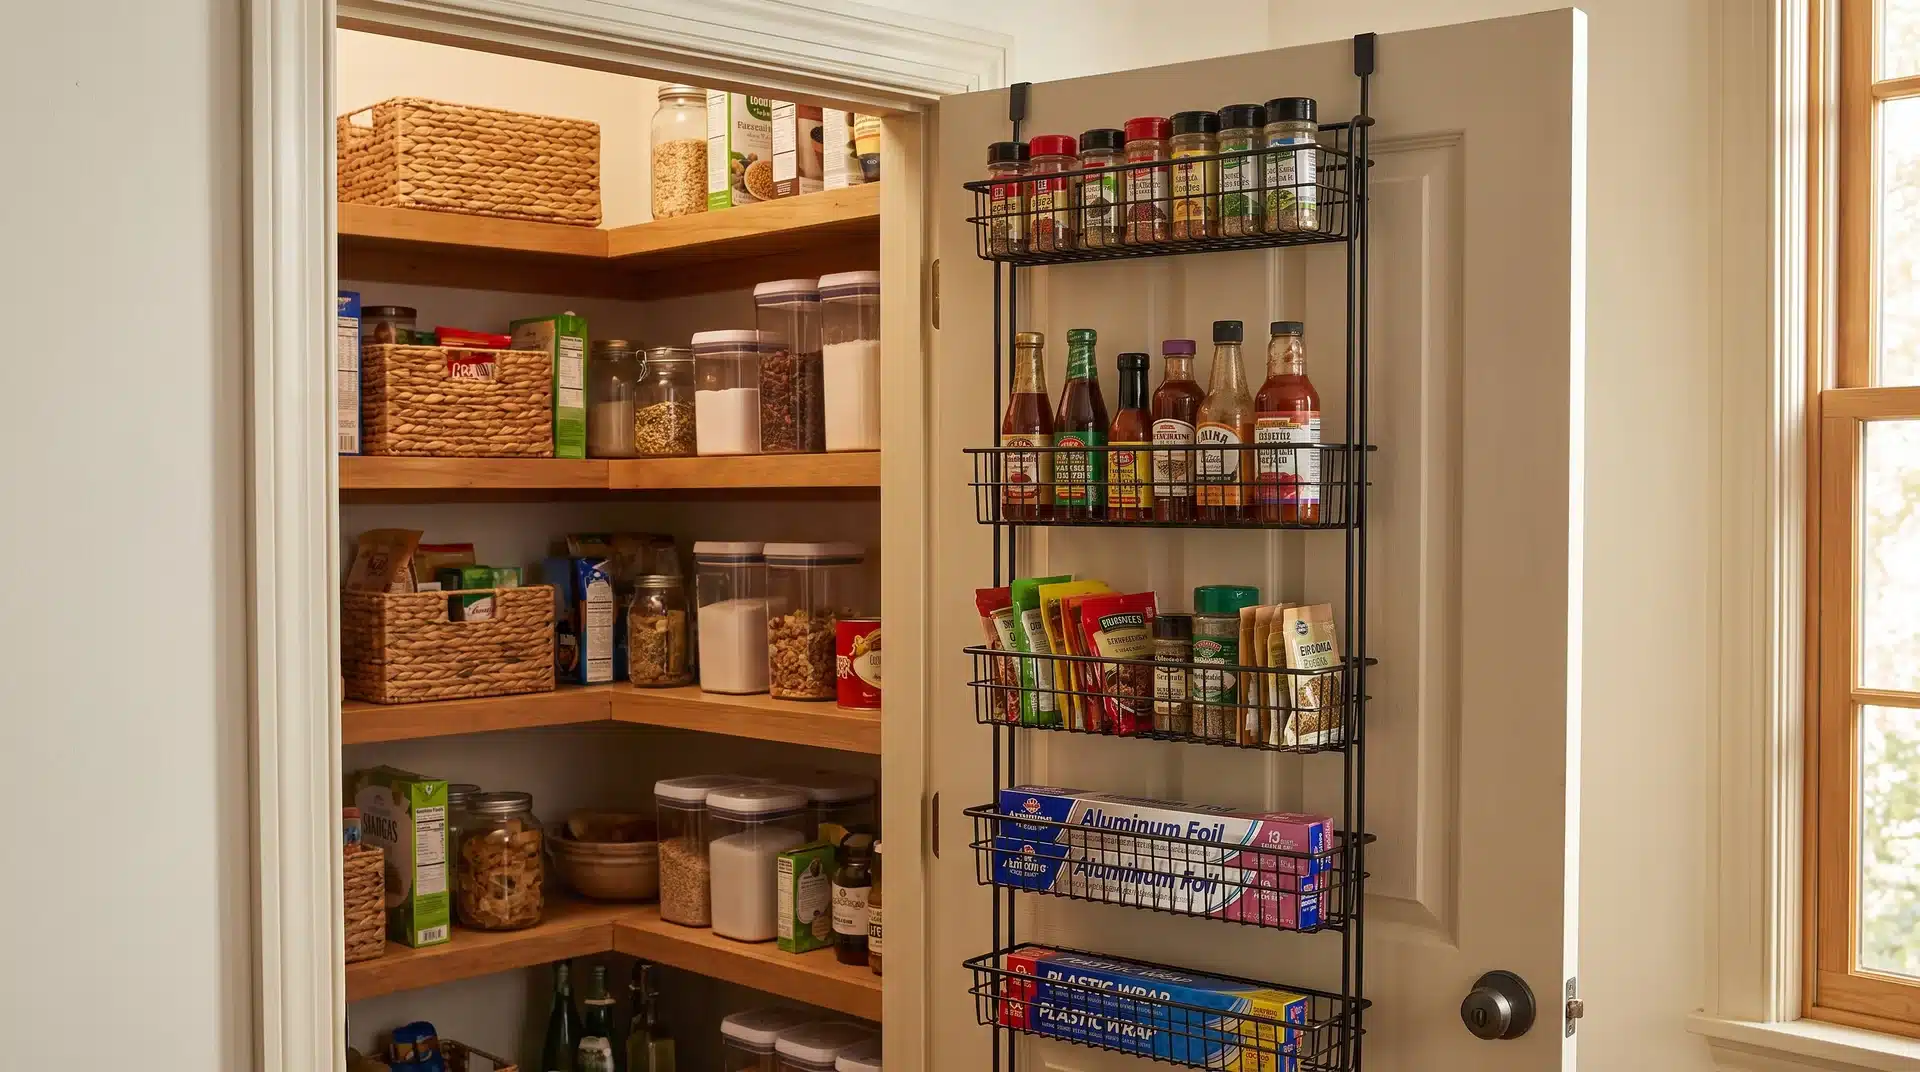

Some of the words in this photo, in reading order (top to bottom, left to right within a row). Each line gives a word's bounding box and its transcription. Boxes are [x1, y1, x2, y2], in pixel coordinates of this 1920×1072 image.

[1080, 808, 1181, 840] Aluminum
[1185, 821, 1226, 843] Foil
[1268, 830, 1281, 844] 13
[1073, 857, 1176, 889] Aluminum
[1179, 871, 1220, 895] Foil
[1045, 970, 1115, 998] PLASTIC
[1117, 983, 1172, 1008] WRAP
[1039, 1002, 1104, 1031] PLASTIC
